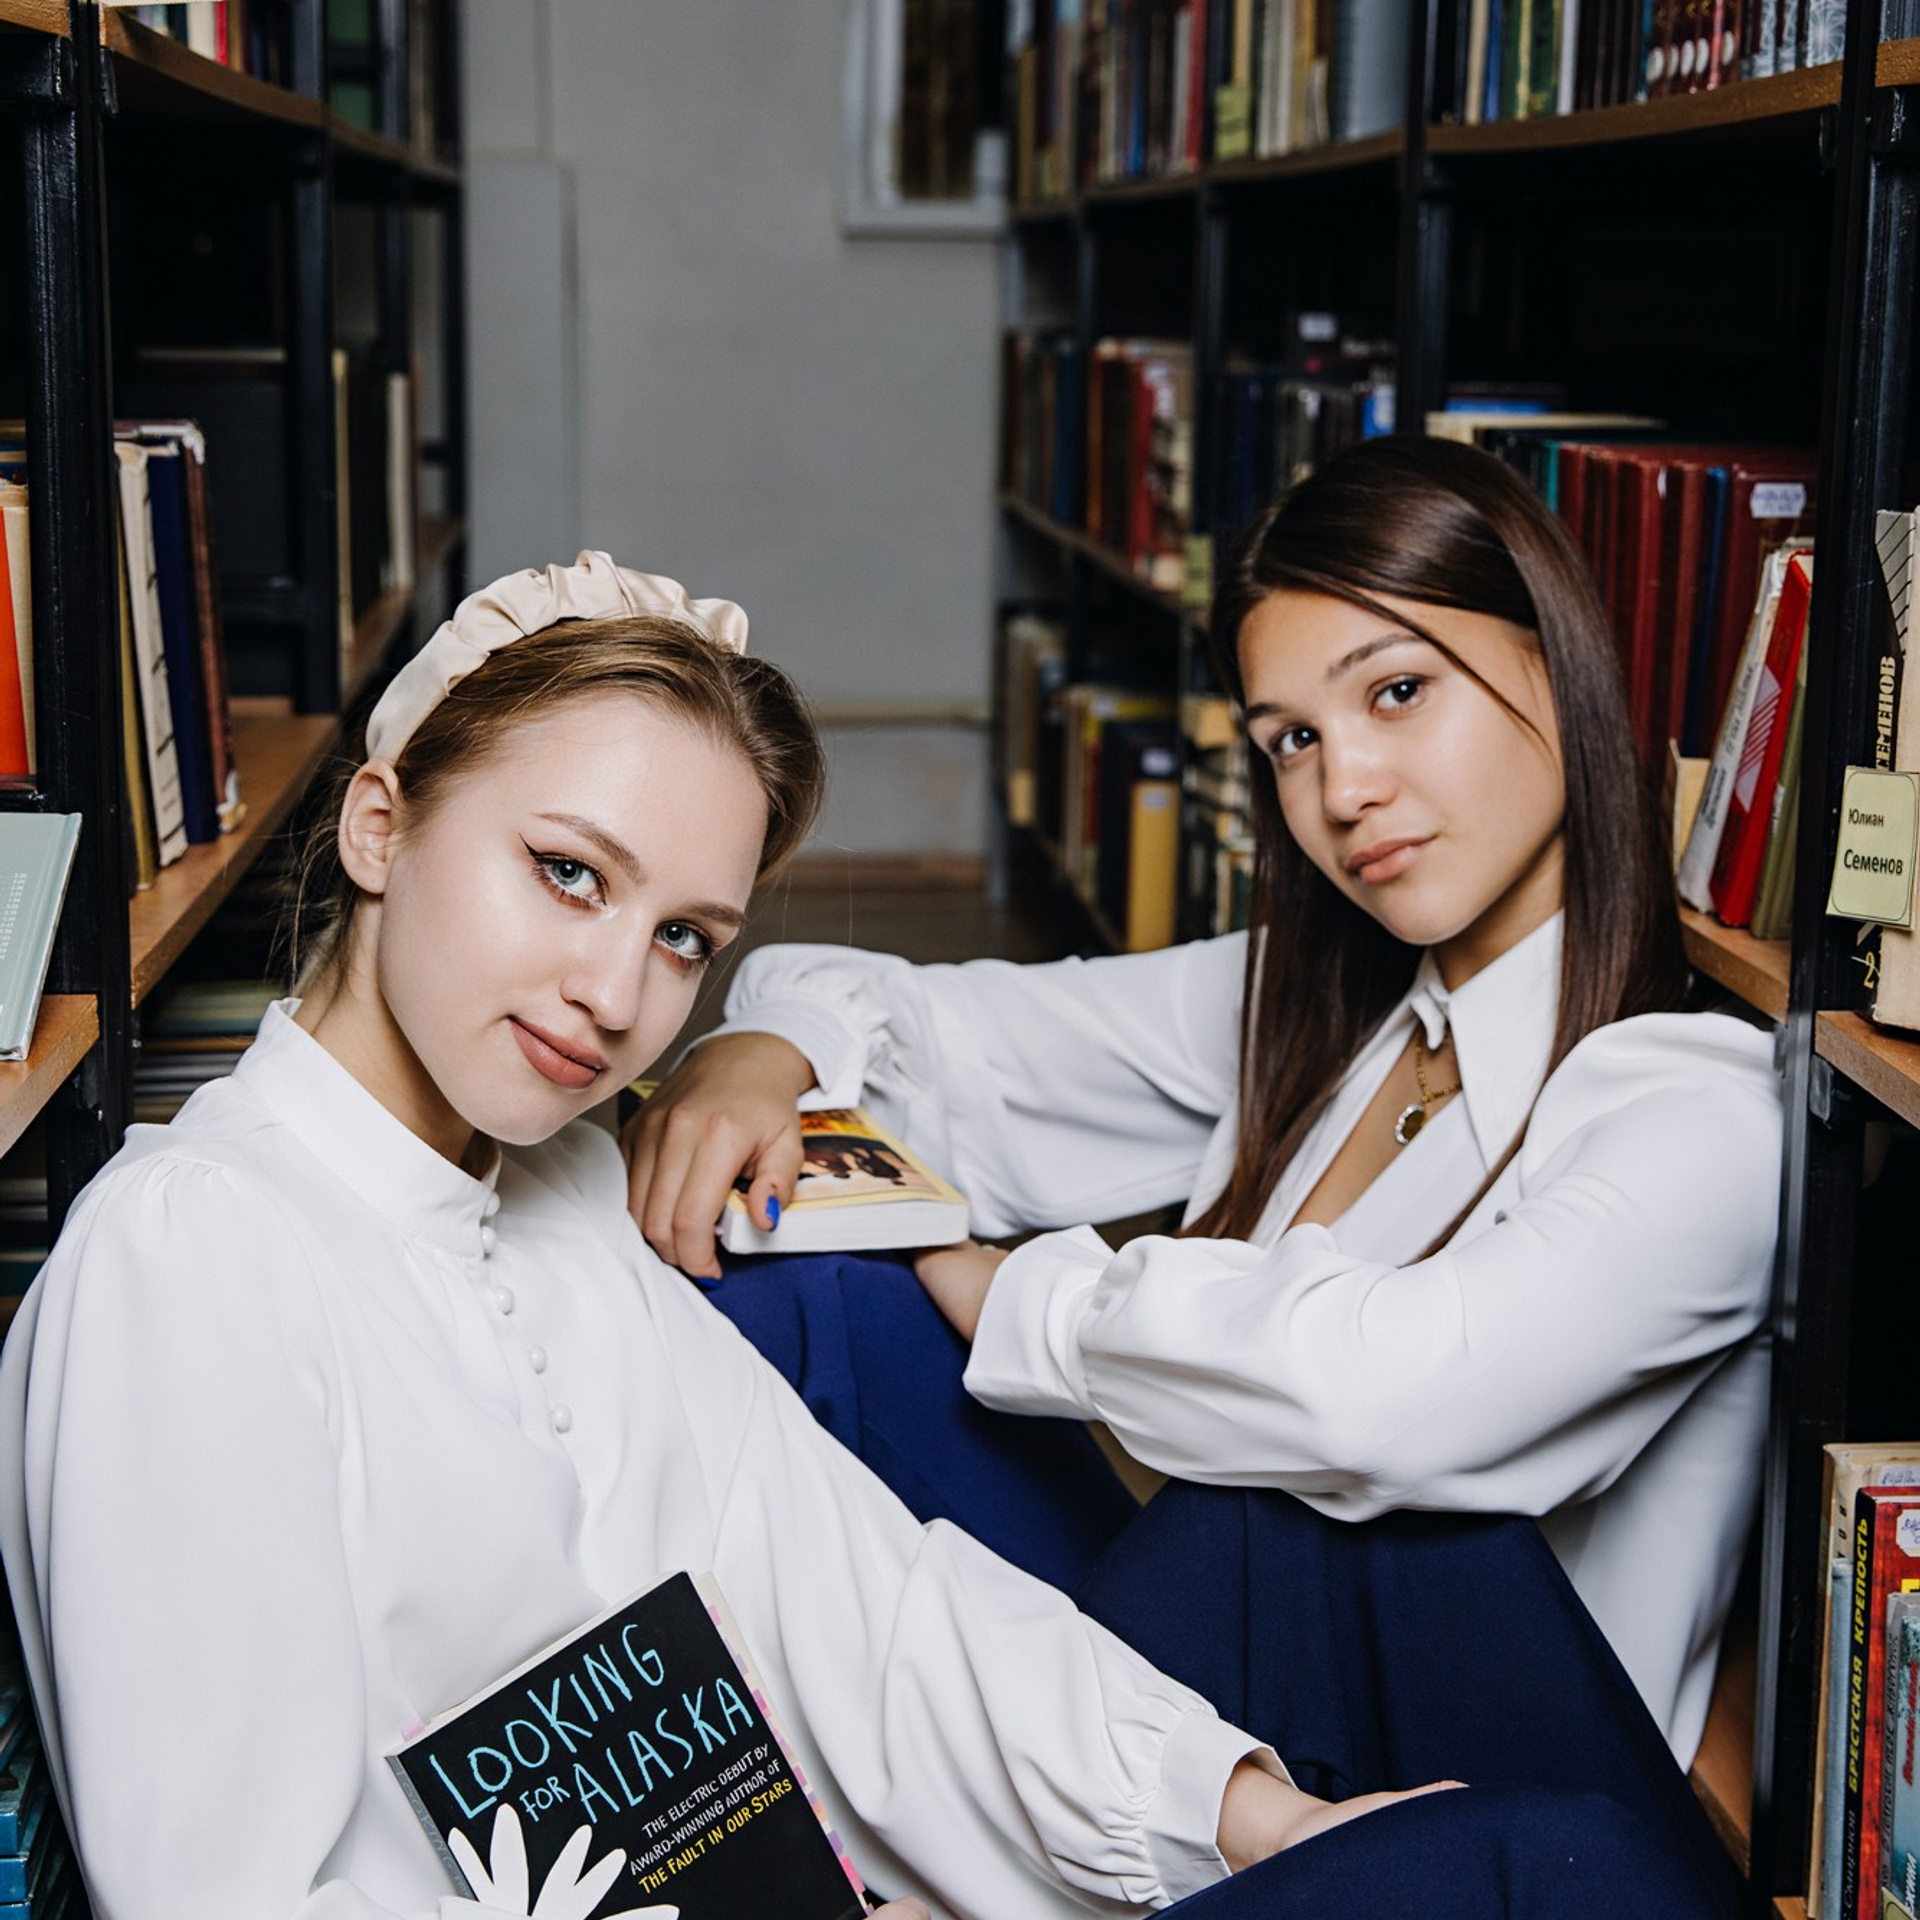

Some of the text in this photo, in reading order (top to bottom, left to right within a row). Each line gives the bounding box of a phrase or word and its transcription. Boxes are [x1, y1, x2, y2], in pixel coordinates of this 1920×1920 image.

[1843, 848, 1903, 876] Семенов
[1848, 808, 1884, 828] Юлиан
[1863, 951, 1876, 990] 2
[1848, 1518, 1868, 1793] БРЕСТСКАЯ КРЕПОСТЬ
[429, 1623, 665, 1820] LOOKING
[519, 1677, 754, 1824] FOR ALASKA
[630, 1758, 781, 1876] AWARD-WINNING AUTHOR OF
[638, 1778, 793, 1894] THE FAULT IN OUR STARS
[642, 1743, 769, 1839] THE ELECTRIC DEBUT BY
